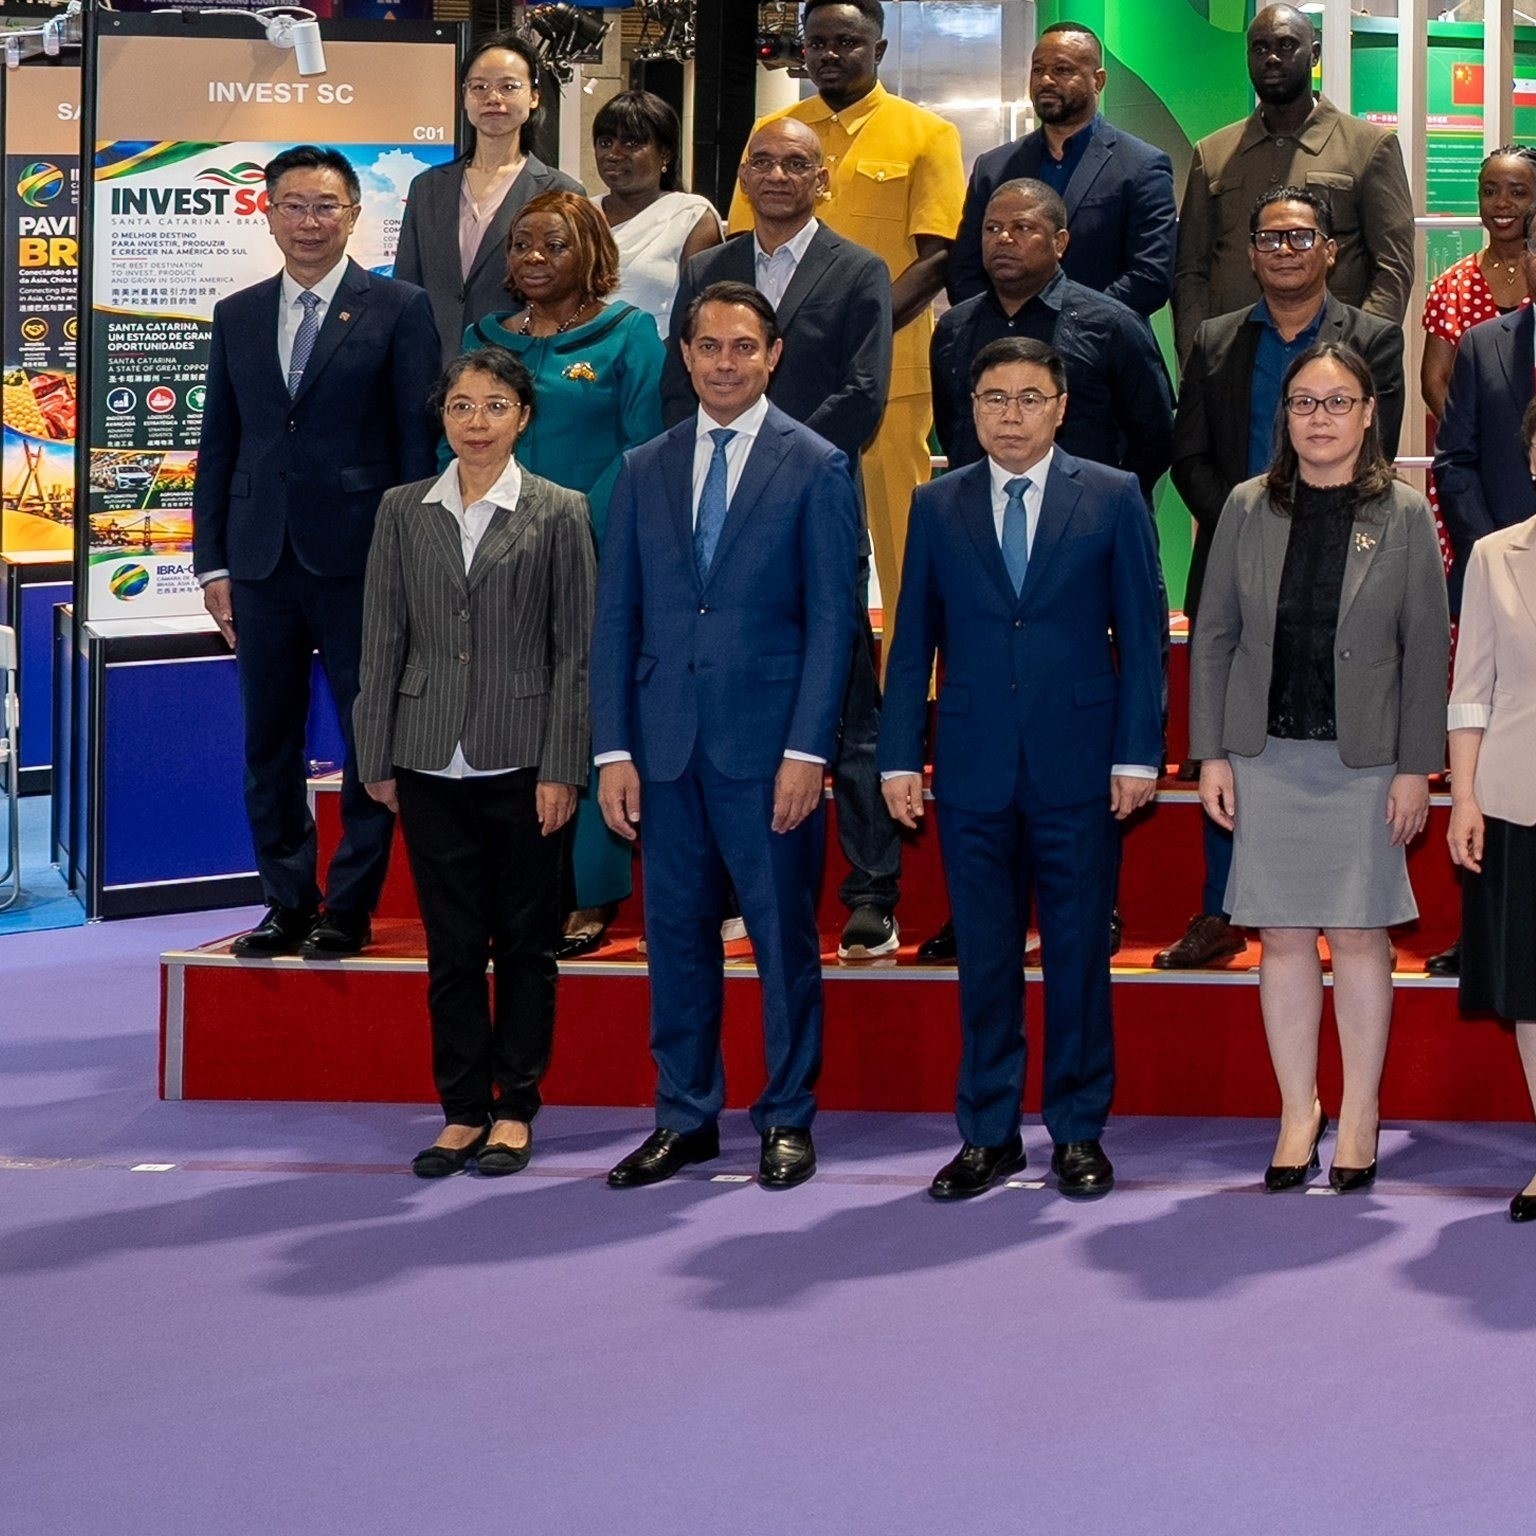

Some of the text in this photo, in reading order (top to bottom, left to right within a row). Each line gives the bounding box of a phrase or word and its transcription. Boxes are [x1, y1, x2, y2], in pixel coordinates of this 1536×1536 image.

[207, 82, 354, 105] INVEST SC
[413, 126, 445, 141] C01
[111, 187, 230, 215] INVEST
[19, 216, 77, 236] PAVI
[137, 240, 181, 248] INVESTIR,
[18, 238, 78, 267] BR
[176, 247, 215, 255] AMÉRICA
[19, 287, 60, 295] Connecting
[108, 322, 199, 332] SANTA CATARINA
[108, 332, 212, 341] UM ESTADO DE GRAN
[107, 342, 195, 351] OPORTUNIDADES
